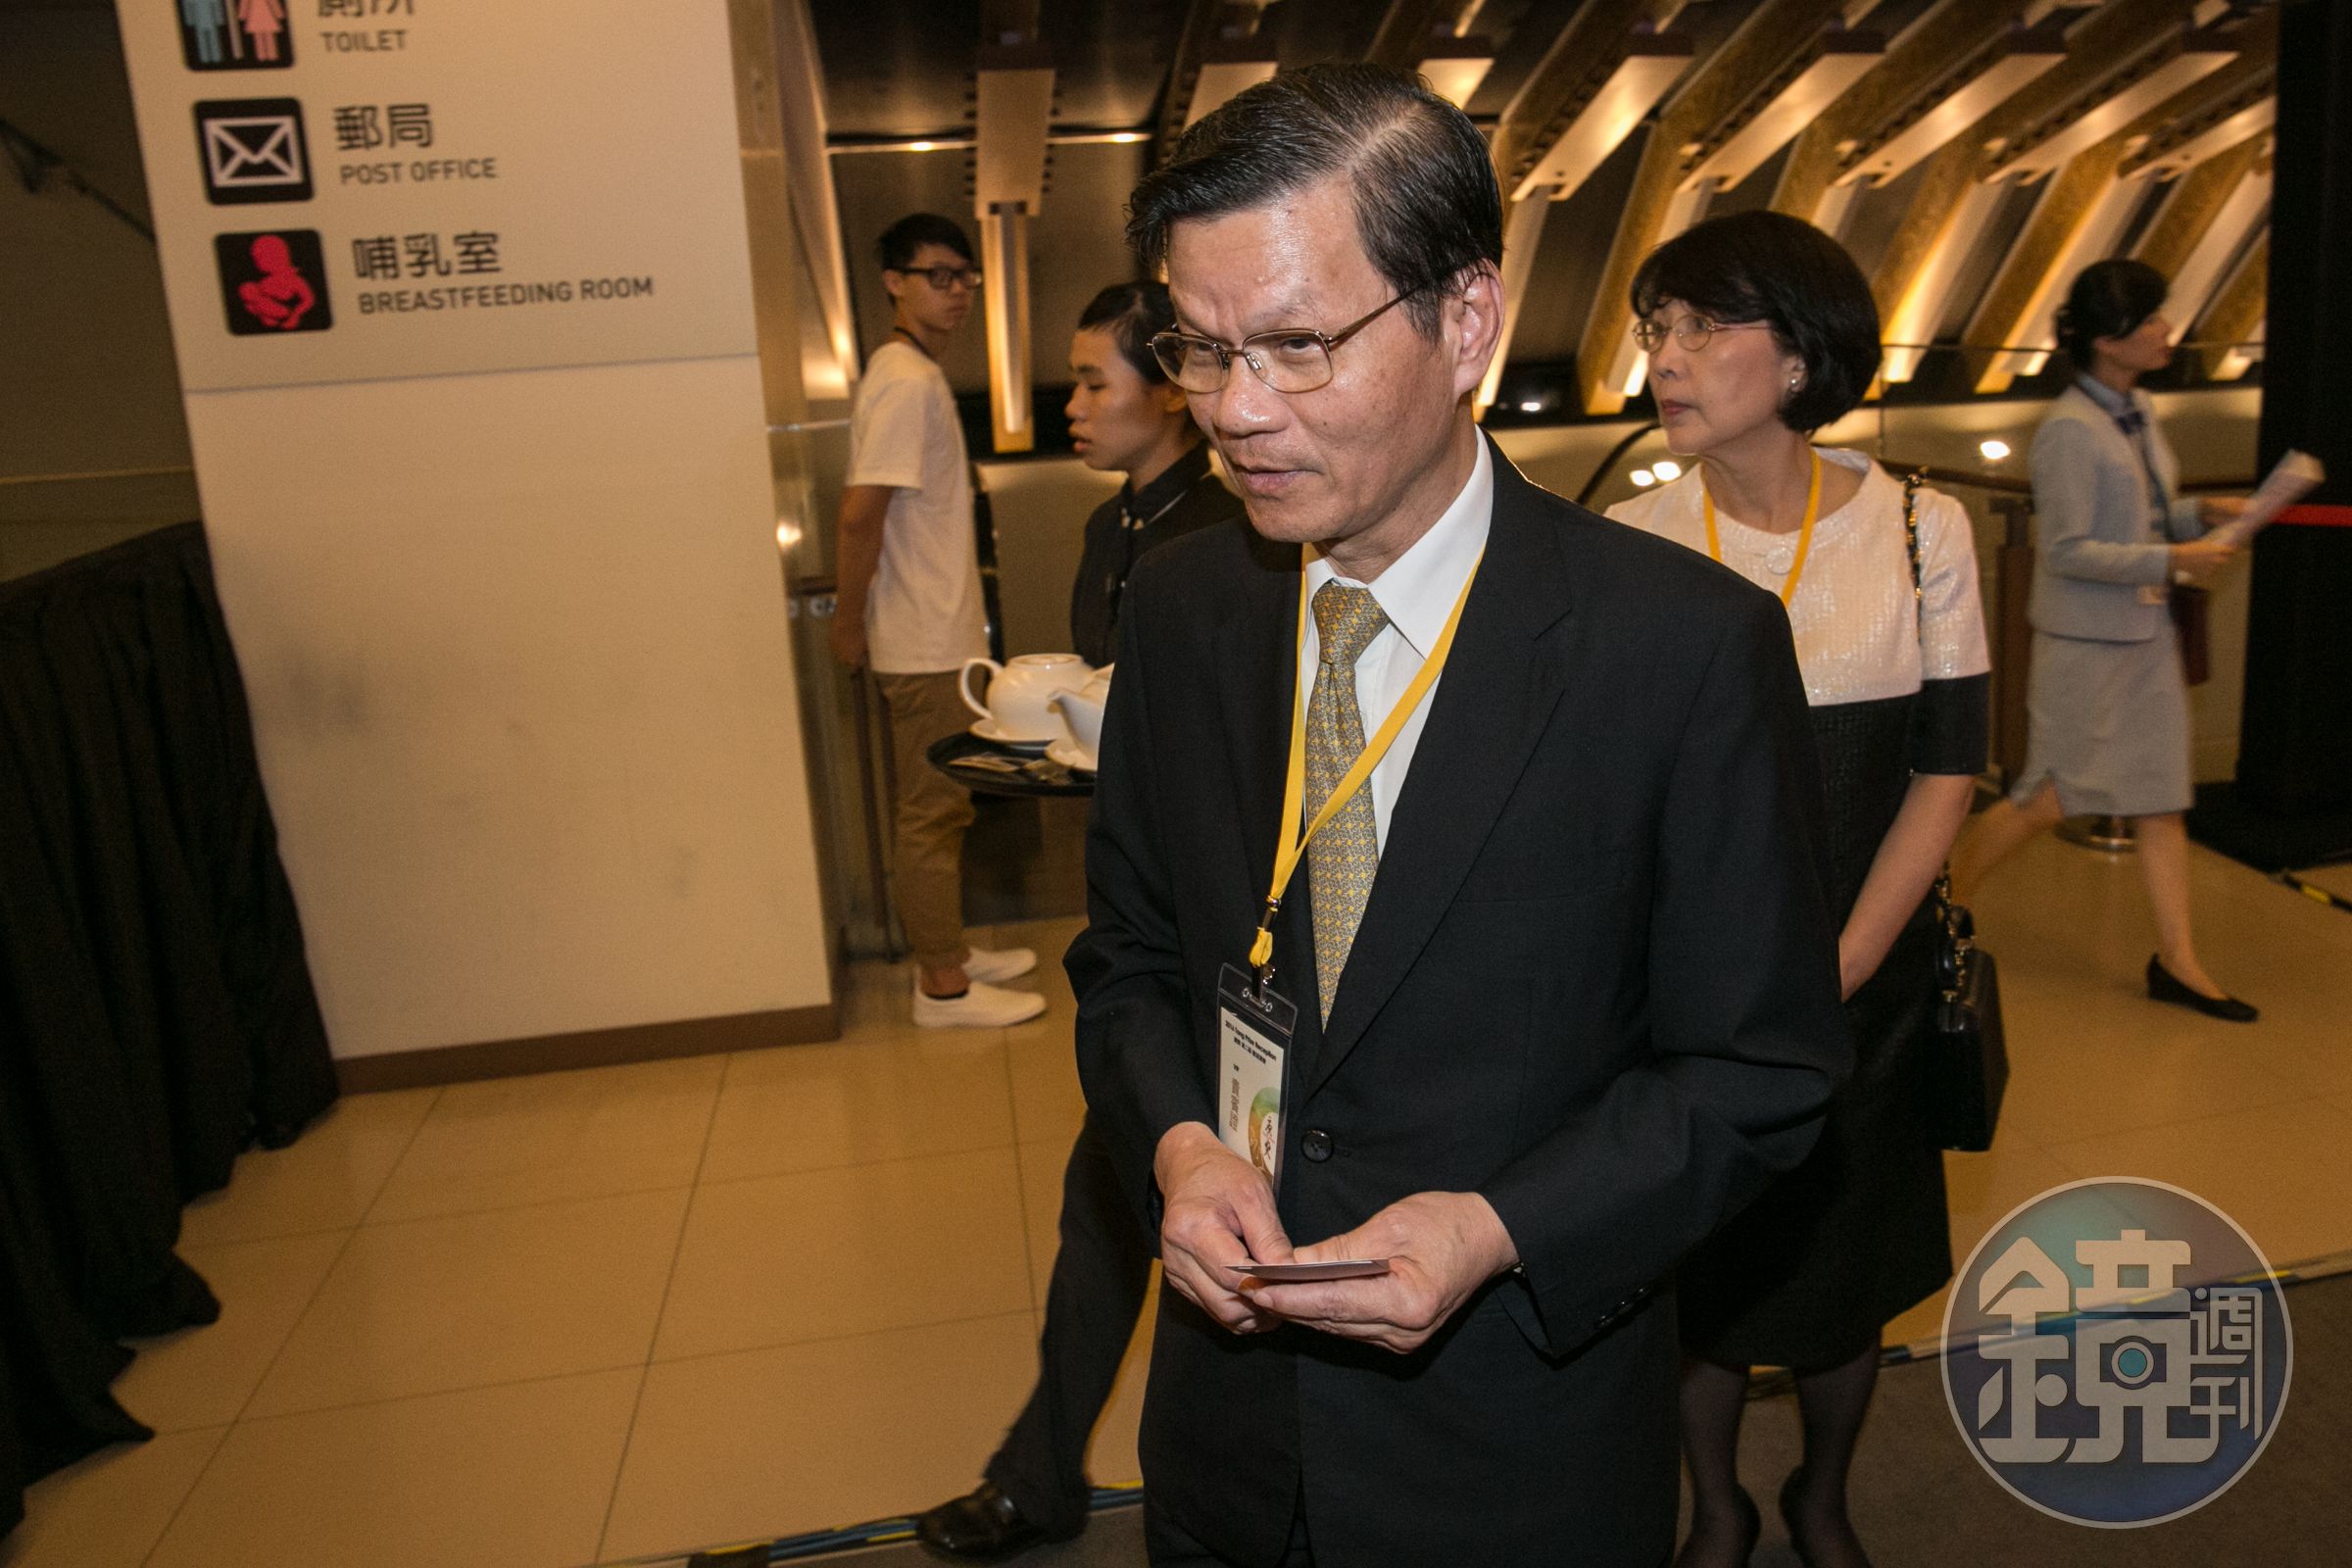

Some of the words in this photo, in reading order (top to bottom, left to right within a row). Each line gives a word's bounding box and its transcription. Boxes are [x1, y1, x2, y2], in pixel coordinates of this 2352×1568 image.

[320, 28, 407, 52] TOILET
[334, 103, 432, 150] 郵局
[340, 162, 402, 184] POST
[410, 157, 497, 182] OFFICE
[351, 230, 501, 279] 哺乳室
[359, 281, 572, 315] BREASTFEEDING
[580, 277, 653, 300] ROOM
